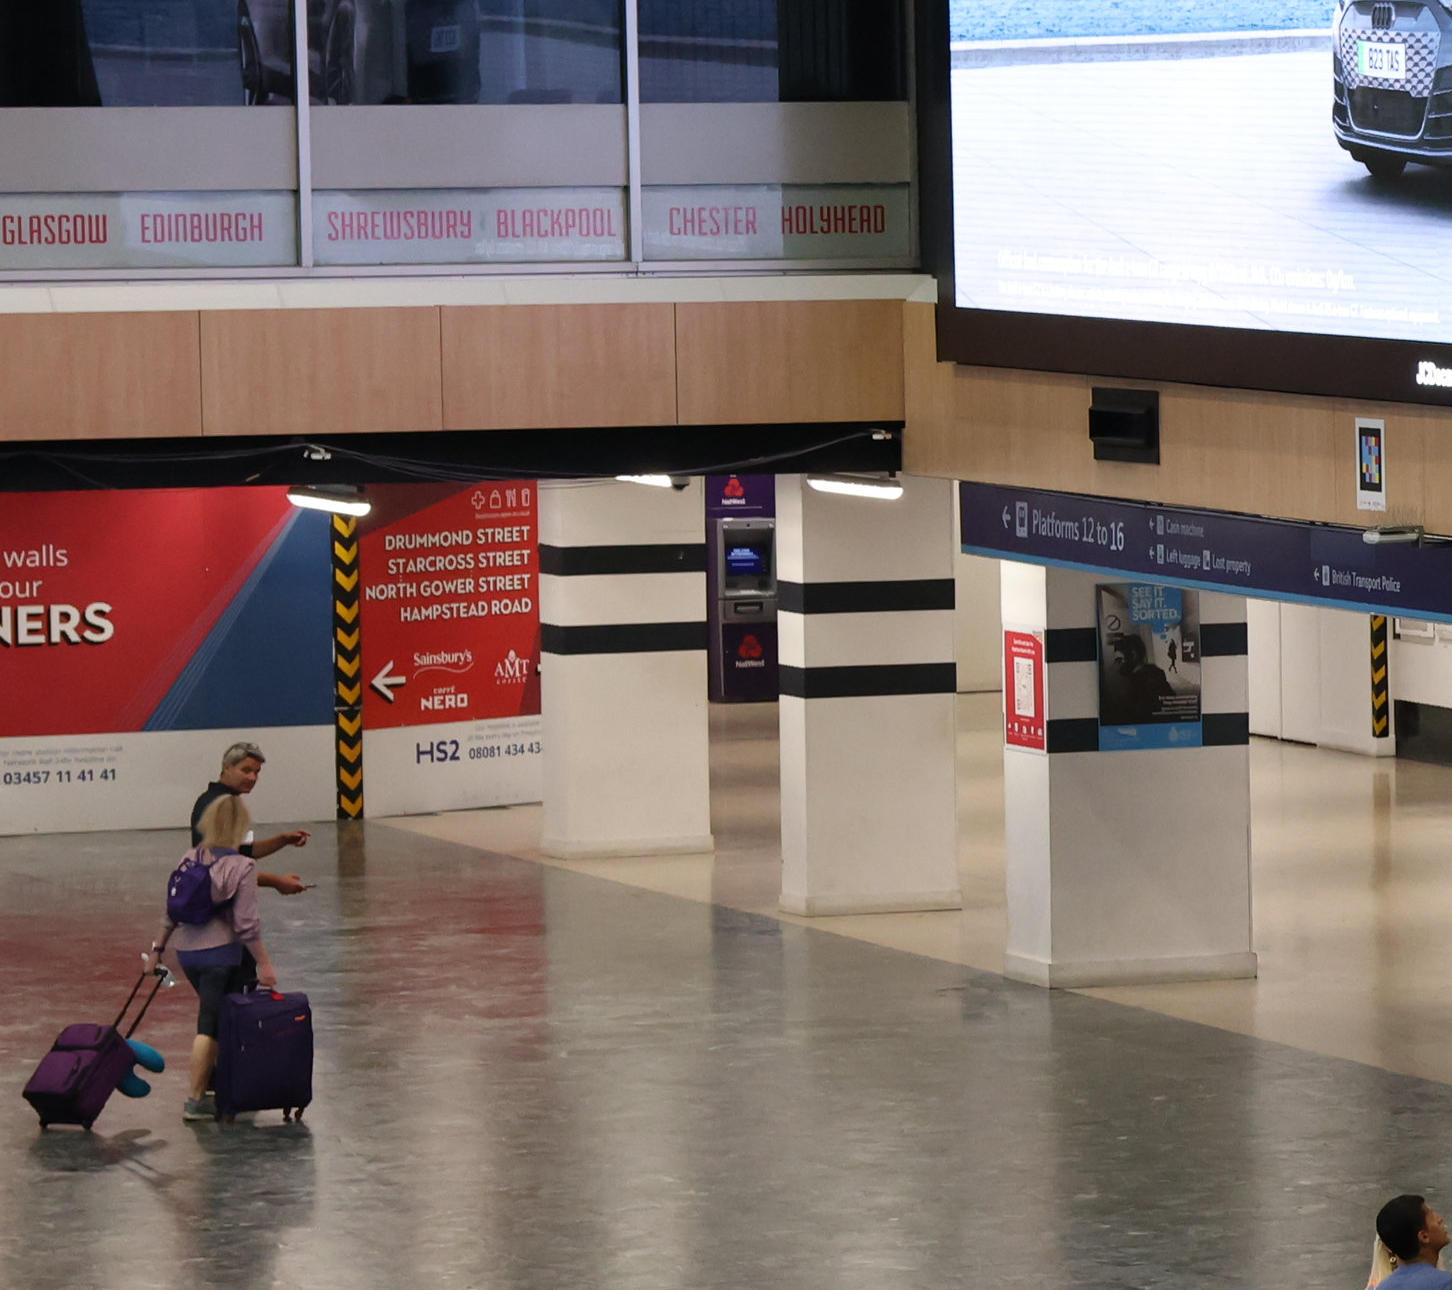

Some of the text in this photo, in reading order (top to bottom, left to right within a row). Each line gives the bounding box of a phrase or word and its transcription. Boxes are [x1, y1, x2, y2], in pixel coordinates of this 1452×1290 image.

[2, 211, 472, 245] GLASGOW EDINBURGH SHREWSBURY
[497, 205, 886, 238] BLACKPOOL CHESTER HOLYHEAD
[385, 526, 530, 550] DRUMMOND STREET
[1032, 509, 1124, 551] Platforms 12 to 16
[1166, 520, 1204, 538] Cash machine
[4, 544, 68, 568] walls
[388, 550, 530, 574] STARCROSS STREET
[1166, 549, 1251, 575] Left luggage Lost property
[366, 574, 531, 600] NORTH GOWER STREET
[1332, 569, 1400, 592] British Transport Police
[1132, 587, 1152, 598] SEE
[1132, 597, 1151, 608] SAY
[401, 598, 531, 622] HAMPSTEAD ROAD
[1133, 609, 1181, 621] SORTED.
[414, 649, 472, 667] Sainsbury's
[494, 659, 529, 678] AMT
[421, 693, 468, 711] NERO
[416, 740, 460, 764] HS2
[469, 746, 500, 759] 08081
[505, 743, 524, 756] 434
[3, 769, 116, 785] 03457 11 41 41
